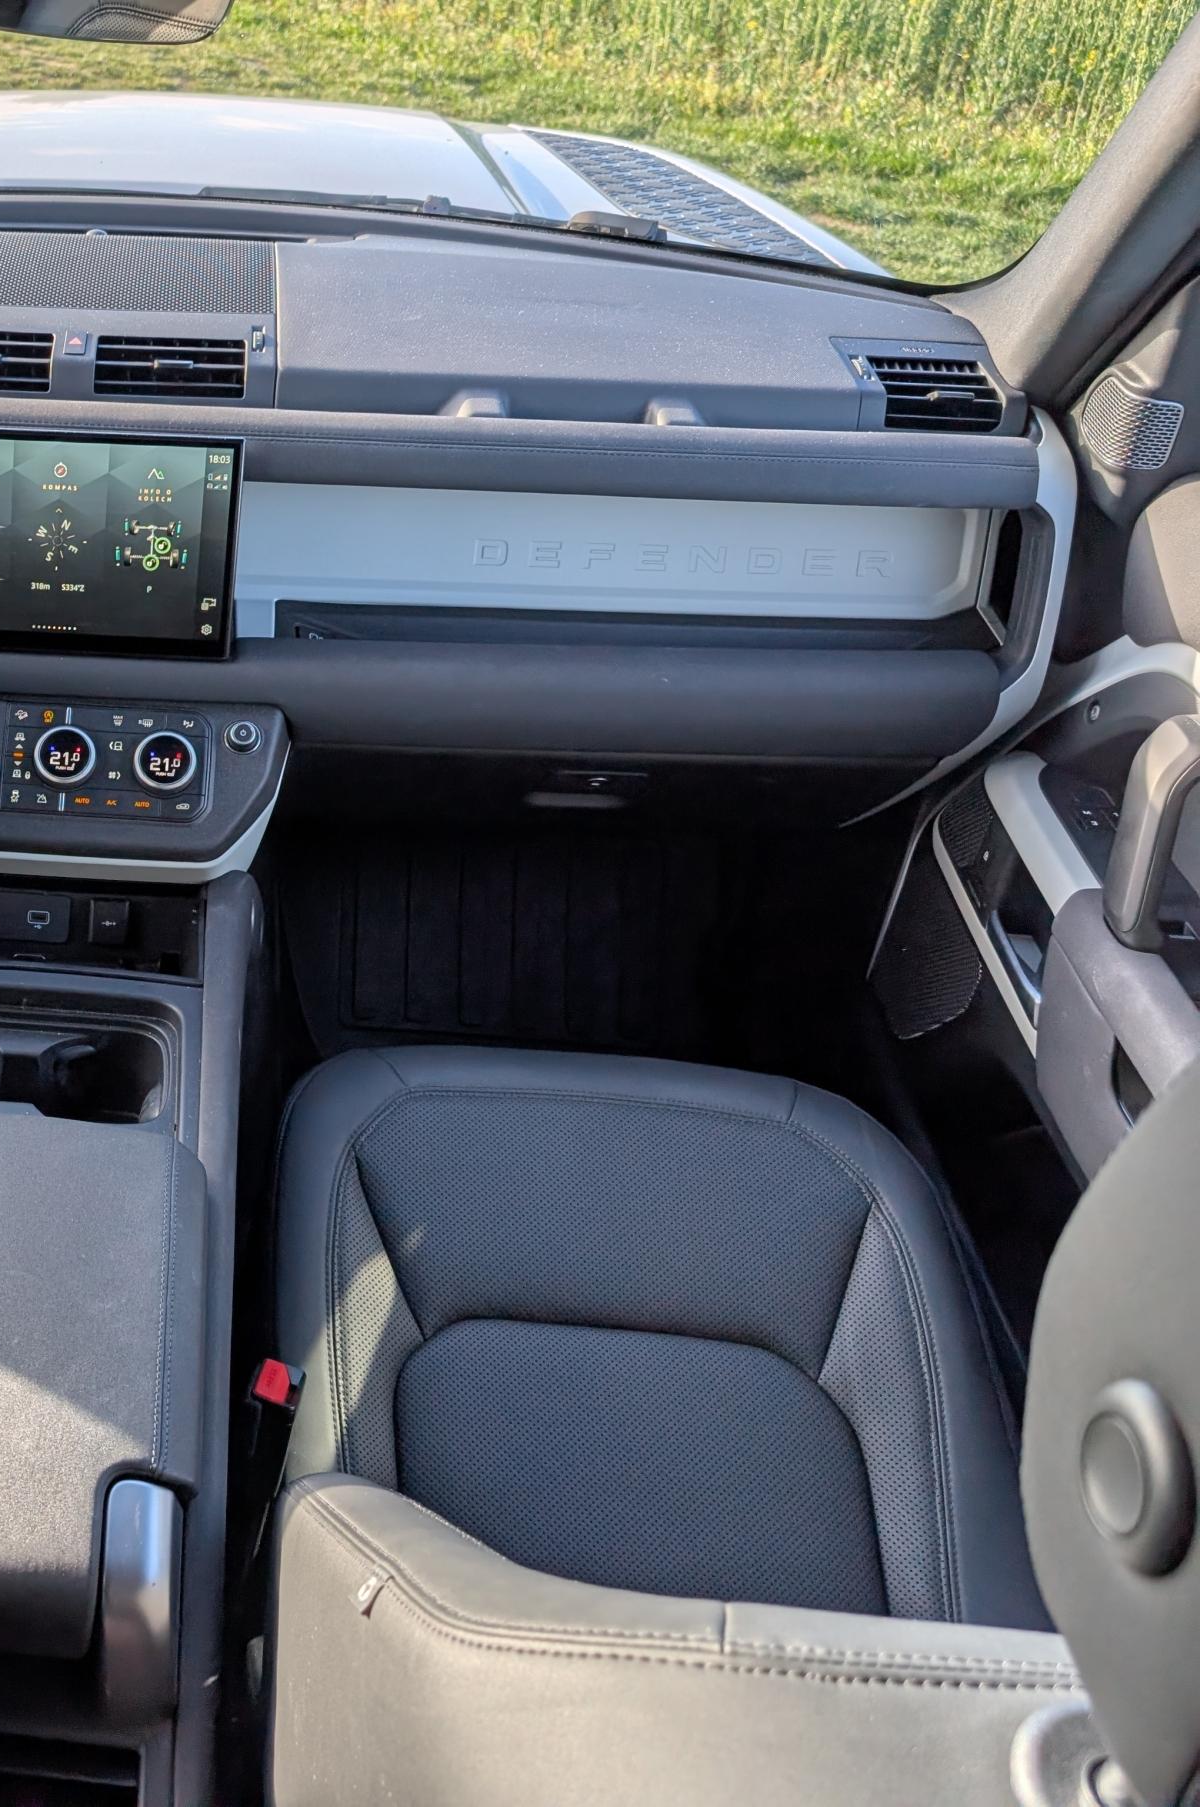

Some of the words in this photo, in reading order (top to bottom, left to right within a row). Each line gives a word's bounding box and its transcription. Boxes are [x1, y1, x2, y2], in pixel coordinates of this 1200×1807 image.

[209, 455, 231, 464] 18:03
[35, 525, 48, 537] W
[61, 519, 71, 531] N
[68, 545, 78, 554] E
[45, 552, 54, 561] S
[473, 537, 892, 579] DEFENDER
[49, 751, 80, 765] 21.0
[149, 757, 181, 771] 21.0
